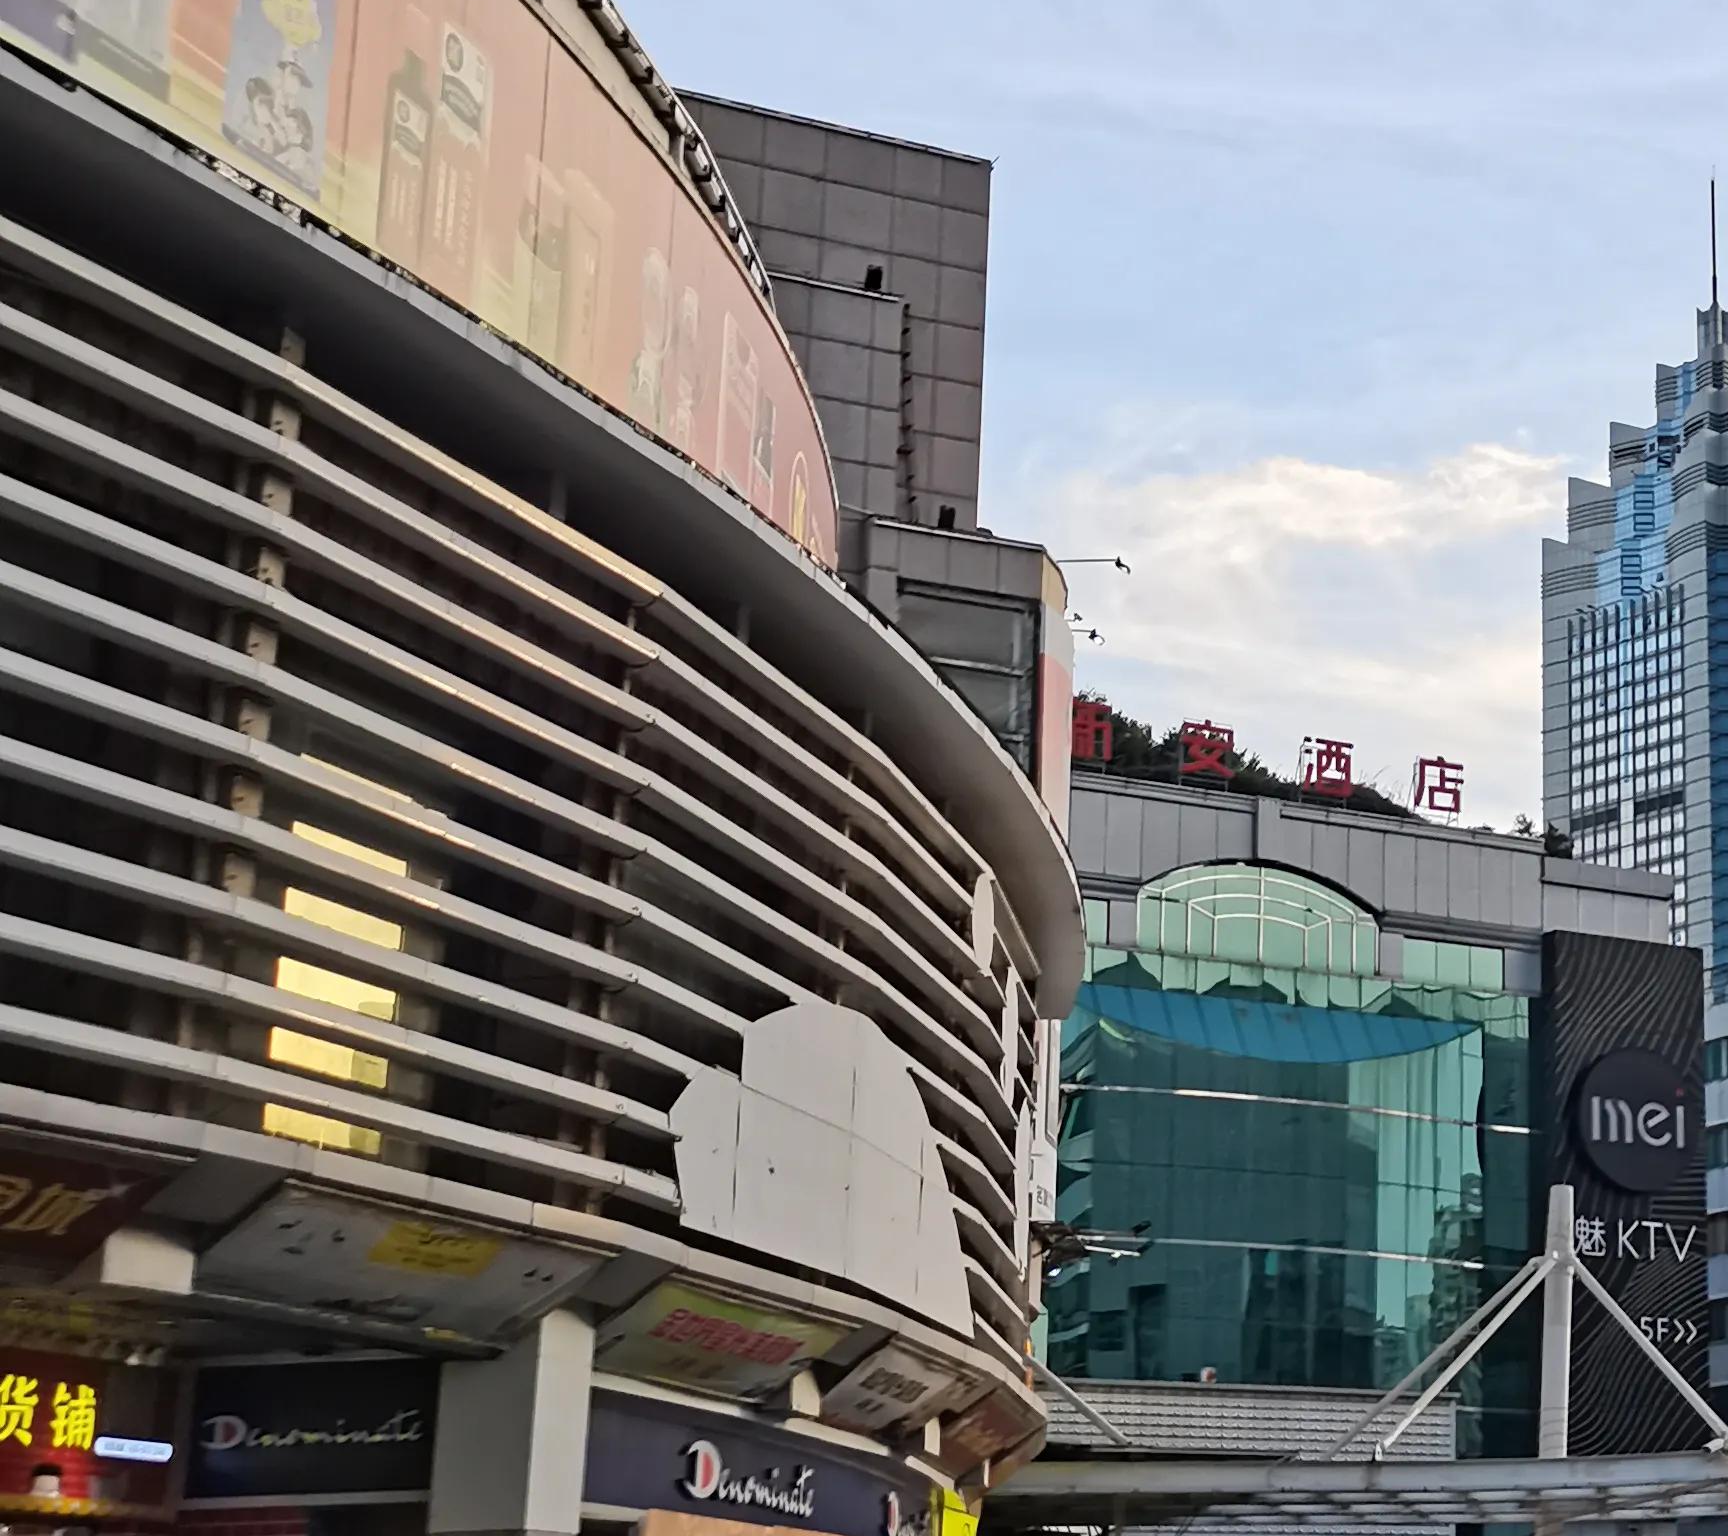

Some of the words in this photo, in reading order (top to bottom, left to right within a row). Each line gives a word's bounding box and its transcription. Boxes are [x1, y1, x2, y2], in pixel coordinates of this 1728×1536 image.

[1591, 1087, 1686, 1150] mei
[1575, 1215, 1606, 1257] 魅
[1617, 1218, 1697, 1263] KTV
[0, 1374, 97, 1450] 货铺
[684, 1440, 816, 1518] Denominate
